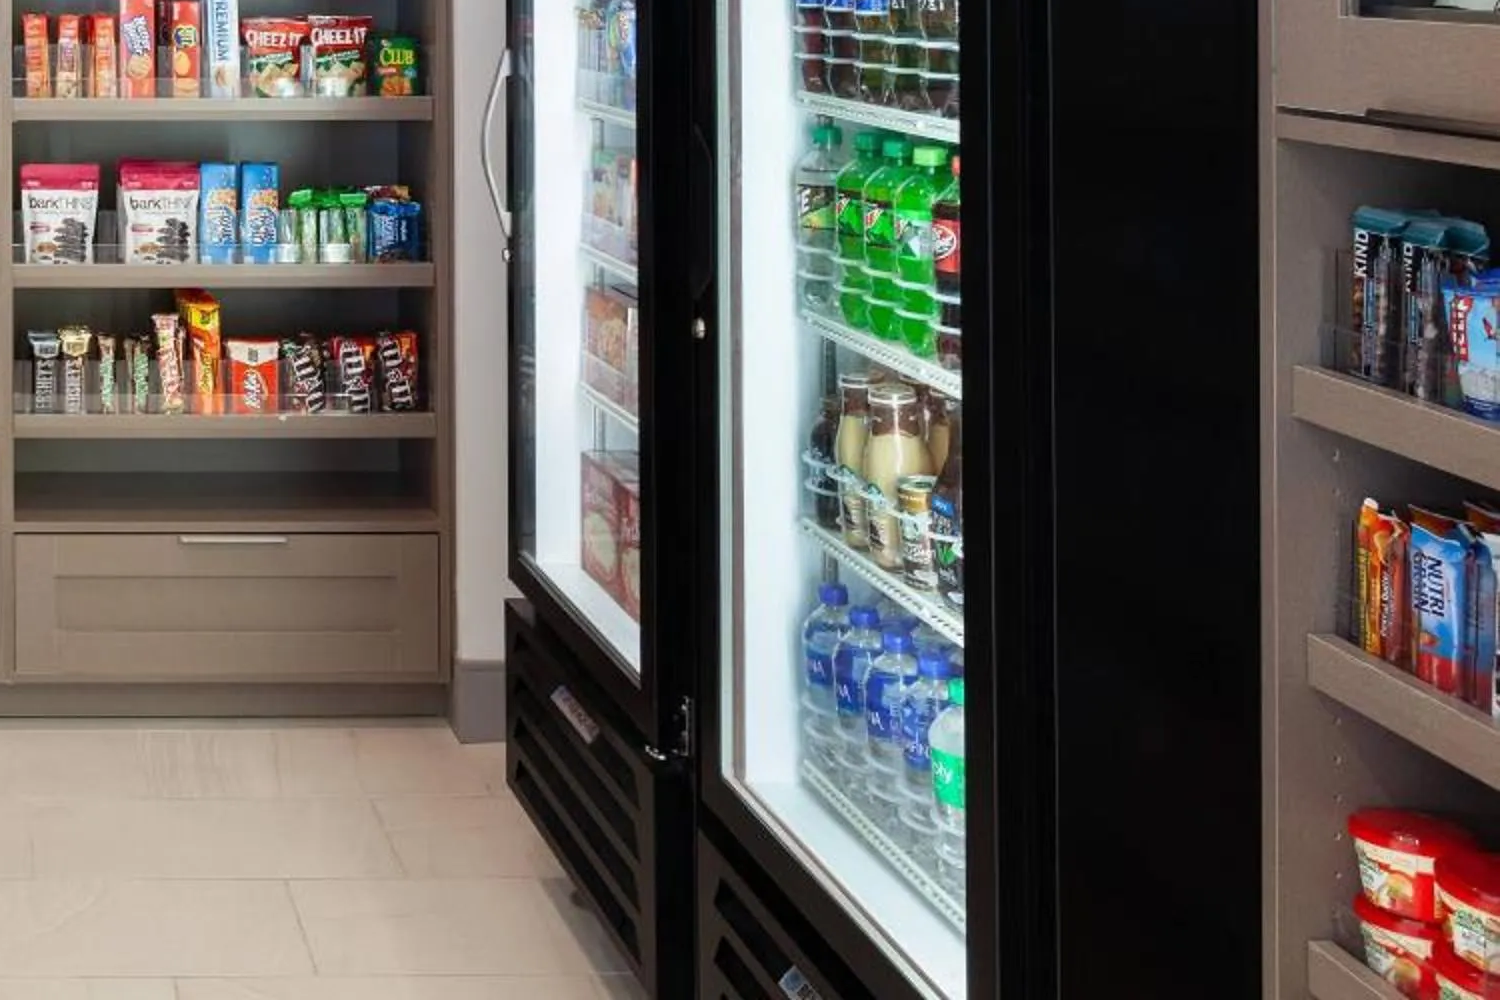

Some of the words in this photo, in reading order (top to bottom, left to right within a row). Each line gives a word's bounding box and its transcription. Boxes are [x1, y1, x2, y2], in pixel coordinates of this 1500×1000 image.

[1354, 228, 1369, 278] KIND
[1412, 551, 1430, 615] GRAIN
[1427, 556, 1445, 617] NUTRI
